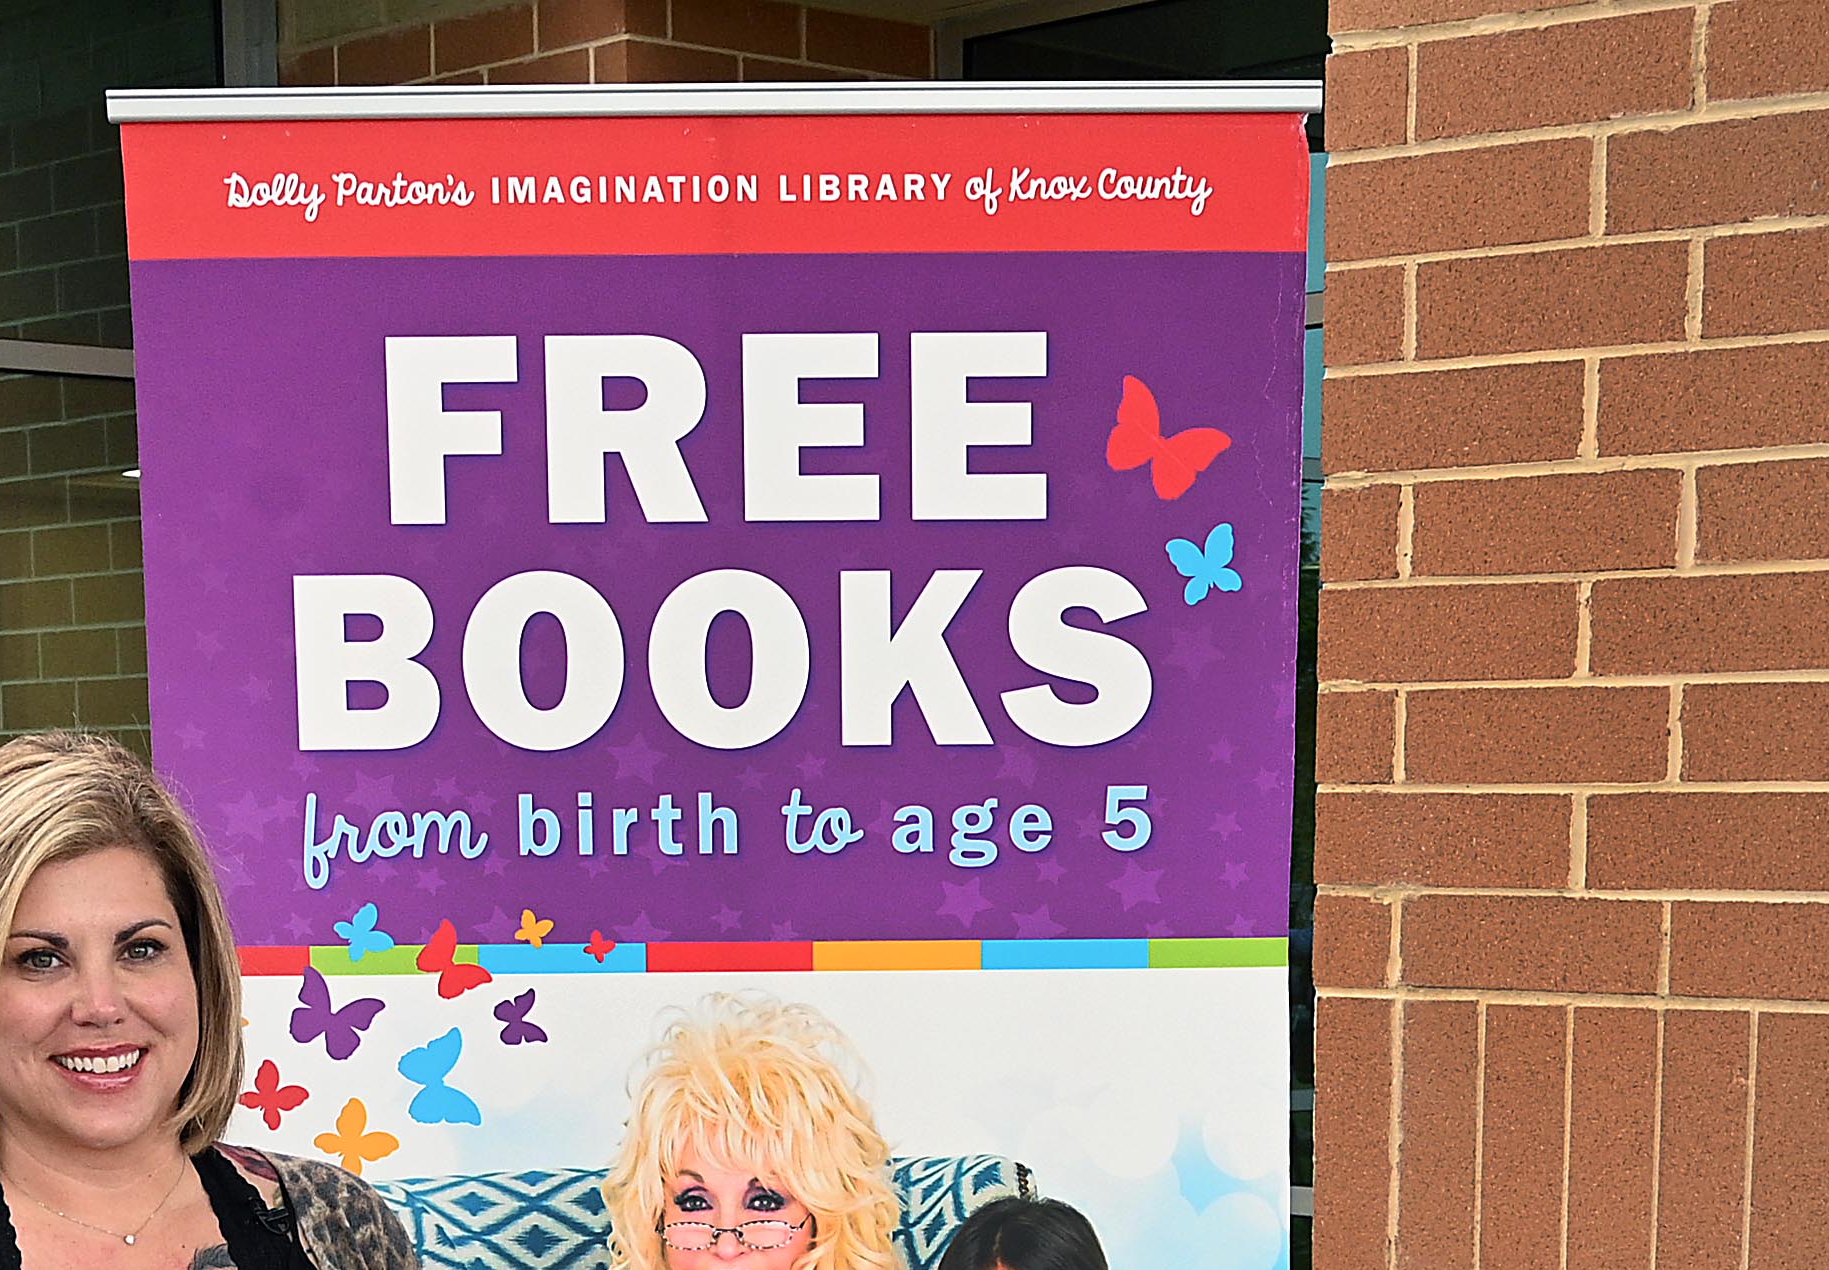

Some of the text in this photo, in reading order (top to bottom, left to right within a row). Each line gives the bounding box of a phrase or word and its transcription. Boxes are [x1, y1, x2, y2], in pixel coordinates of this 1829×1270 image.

[224, 167, 1212, 221] Dolly Parton's IMAGINATION LIBRARY of Knox County
[385, 332, 1046, 524] FREE
[293, 567, 1151, 750] BOOKS
[304, 786, 1151, 889] from birth to age 5
